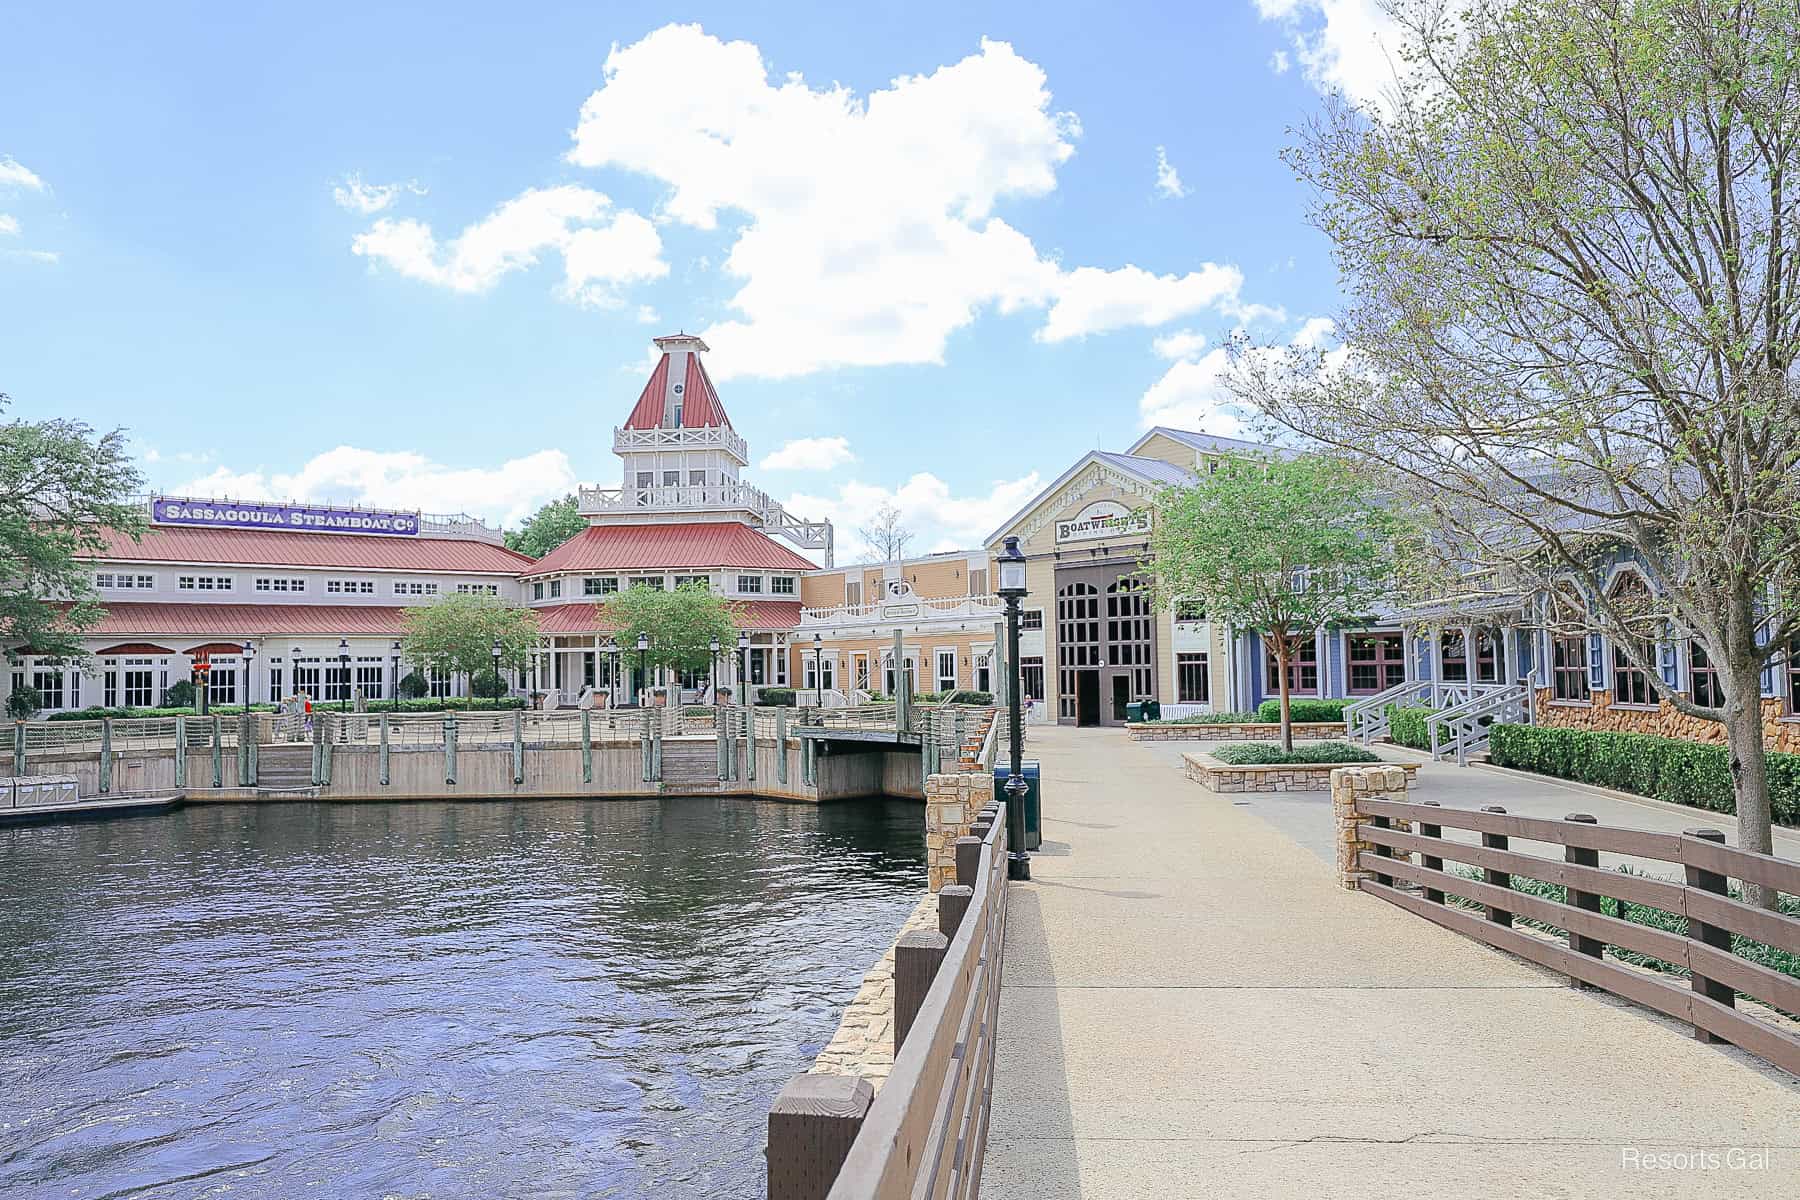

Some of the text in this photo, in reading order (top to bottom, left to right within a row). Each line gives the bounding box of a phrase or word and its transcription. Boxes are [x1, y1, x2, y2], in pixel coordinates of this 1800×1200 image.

[166, 504, 284, 524] SASSAGOULA
[290, 512, 392, 530] STEAMBOAT
[1059, 510, 1148, 539] BOATWRGHTS
